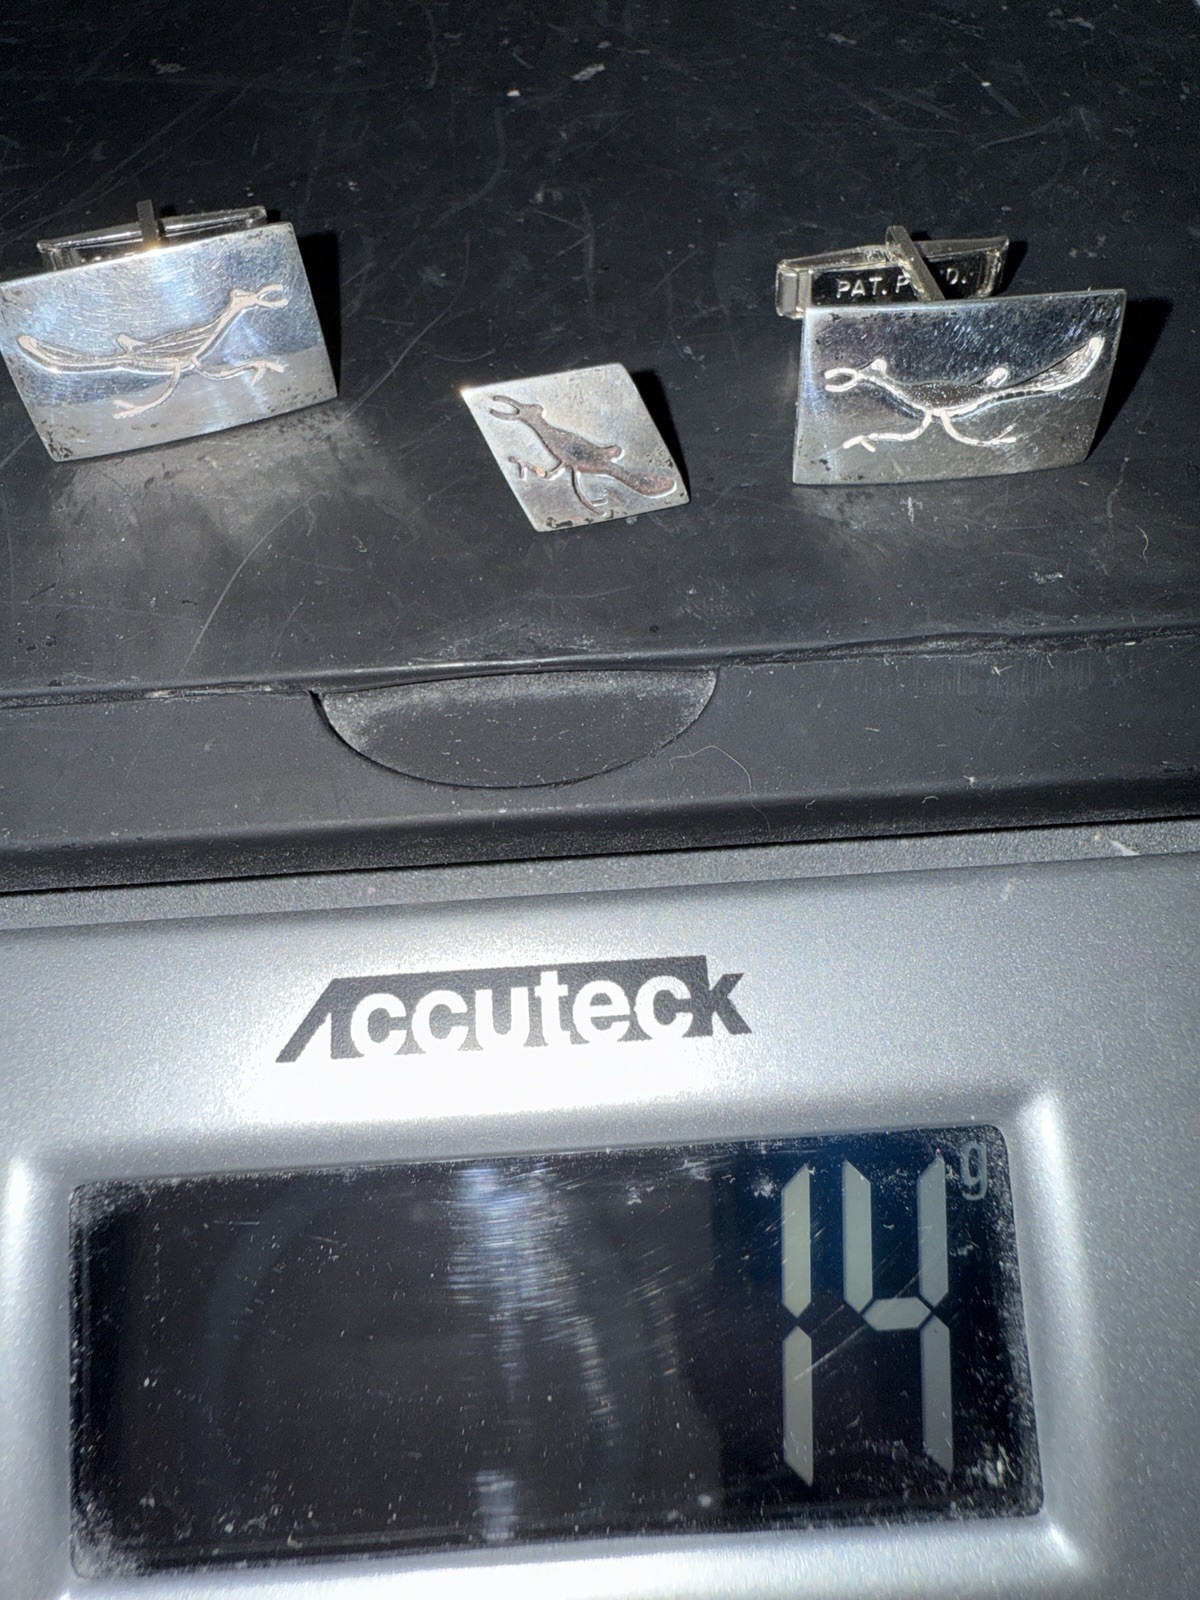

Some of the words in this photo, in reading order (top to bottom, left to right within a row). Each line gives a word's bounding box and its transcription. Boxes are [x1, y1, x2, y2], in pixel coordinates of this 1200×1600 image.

[837, 276, 887, 298] PAT.
[781, 1158, 953, 1486] 14
[960, 1142, 987, 1200] g
